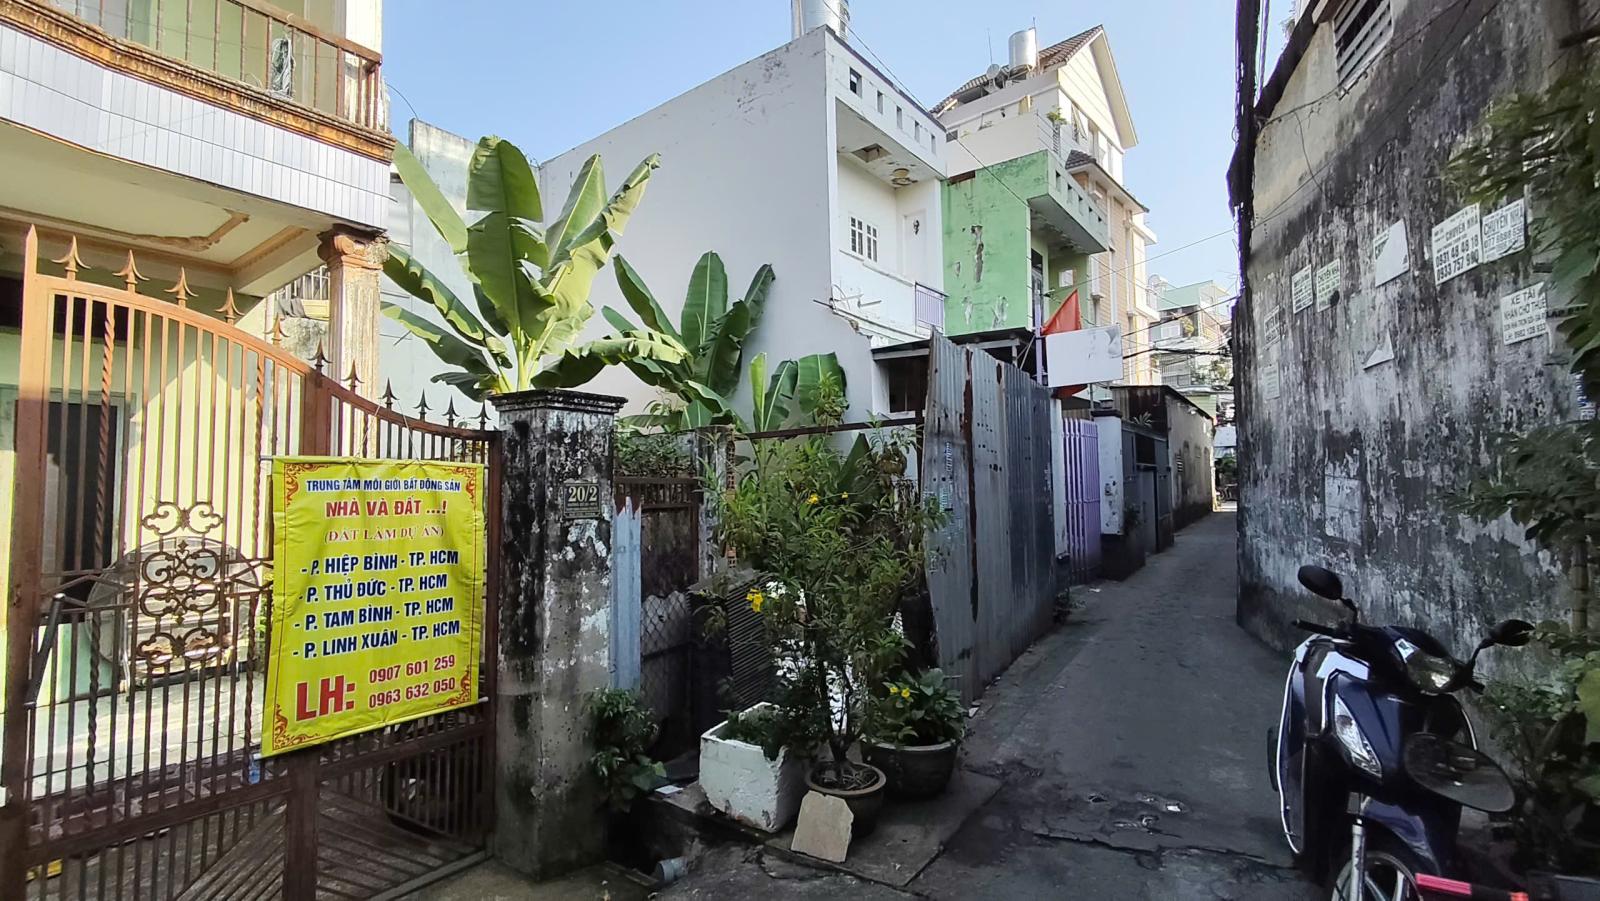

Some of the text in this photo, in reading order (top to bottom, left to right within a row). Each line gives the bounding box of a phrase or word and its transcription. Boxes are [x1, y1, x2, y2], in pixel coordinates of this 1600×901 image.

[1453, 256, 1464, 274] 757
[1511, 294, 1521, 305] XE
[306, 480, 340, 492] TRUNG
[343, 477, 361, 490] TÂM
[364, 477, 383, 490] MÔI
[420, 478, 443, 492] ĐỘNG
[568, 485, 598, 502] 20/2
[326, 497, 360, 518] NHÀ
[366, 498, 389, 516] VÀ
[394, 495, 422, 515] ĐẤT
[364, 527, 396, 541] LÀM
[311, 560, 320, 576] P.
[325, 554, 359, 576] HIỆP
[363, 552, 398, 571] BÌNH
[409, 553, 426, 567] TP.
[430, 550, 459, 565] HCM
[307, 587, 319, 603] P.
[324, 578, 353, 600] THỦ
[357, 579, 387, 597] ĐỨC
[399, 578, 415, 593] TP.
[419, 574, 447, 591] HCM
[305, 614, 318, 631] P.
[323, 610, 354, 629] TAM
[358, 604, 393, 625] BÌNH
[404, 602, 421, 617] TP.
[426, 597, 454, 614] HCM
[304, 642, 317, 659] P.
[323, 636, 357, 657] LINH
[361, 629, 398, 650] XUÂN
[411, 626, 429, 641] TP.
[433, 620, 460, 638] HCM
[370, 654, 455, 683] 0907 601 259
[296, 675, 356, 722] LH:
[369, 677, 456, 708] 0963 632 050
